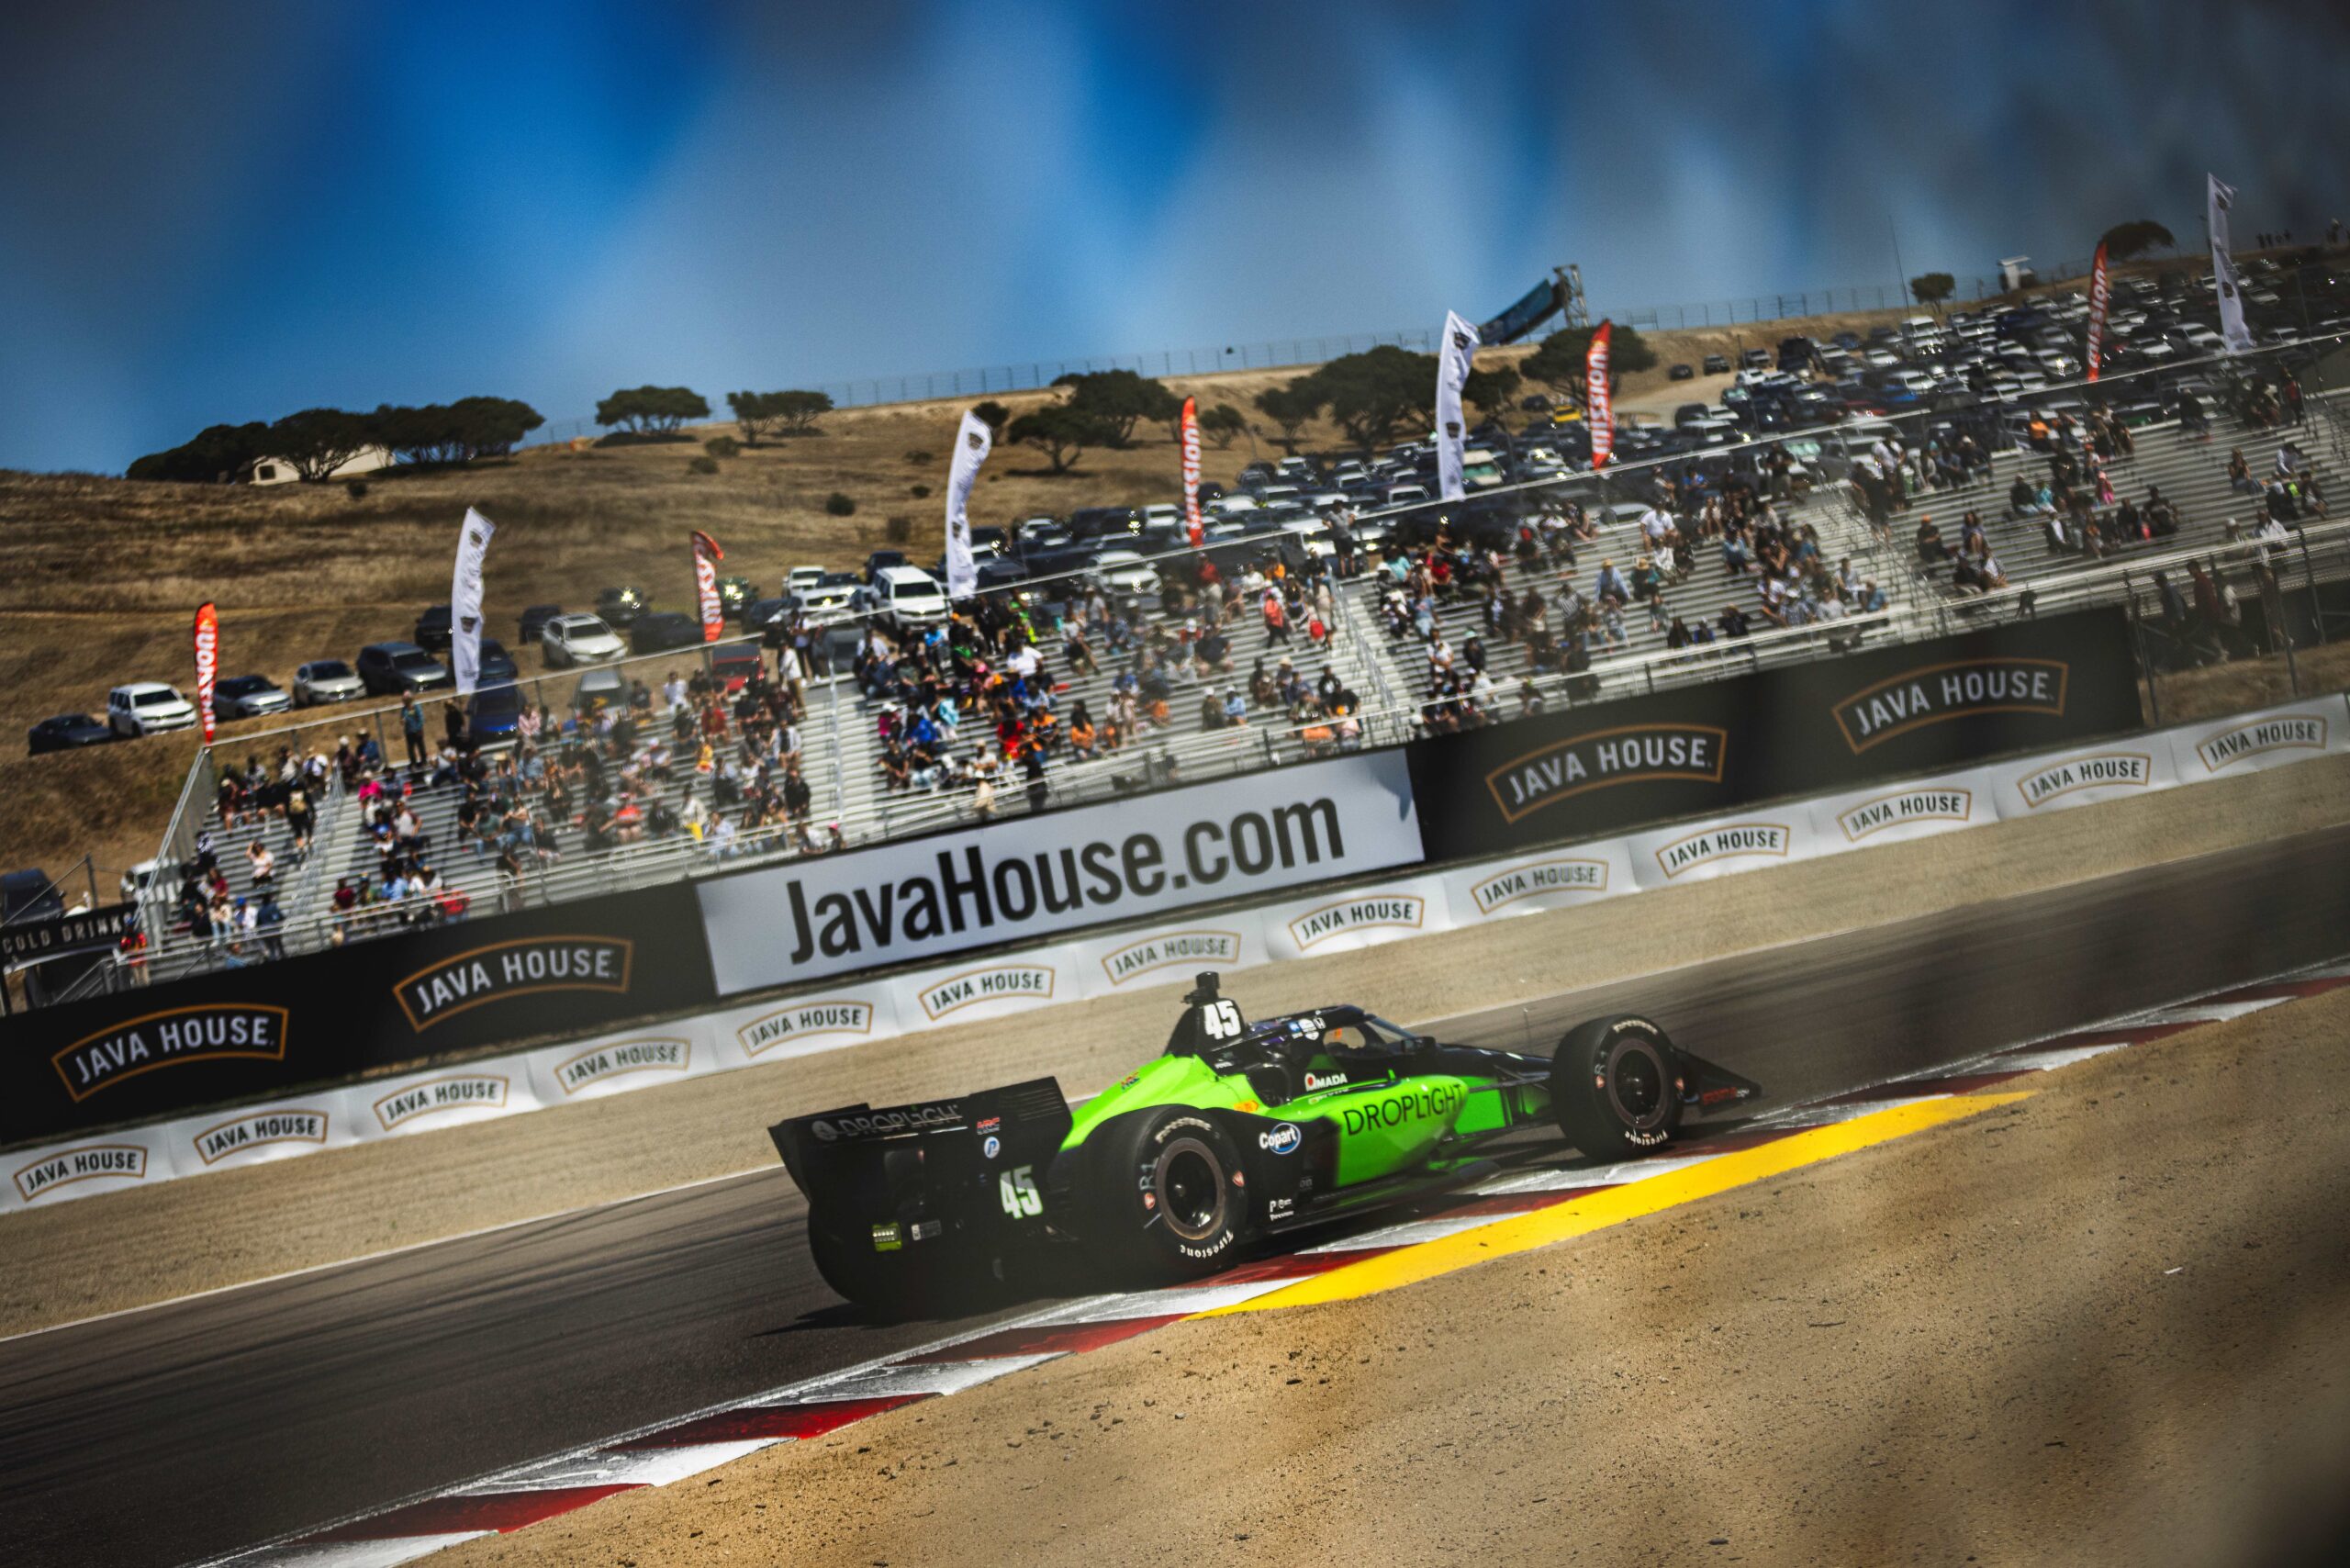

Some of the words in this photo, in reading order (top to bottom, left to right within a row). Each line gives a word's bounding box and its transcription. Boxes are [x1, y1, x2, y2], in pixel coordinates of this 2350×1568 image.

[1855, 685, 1931, 735] JAVA
[2210, 735, 2253, 764] JAVA
[2256, 722, 2317, 747] HOUSE
[1508, 752, 1588, 804] JAVA
[2029, 769, 2074, 799] JAVA
[2079, 760, 2142, 782] HOUSE
[1852, 803, 1895, 833] JAVA
[1899, 794, 1962, 816] HOUSE
[1667, 838, 1713, 868] JAVA
[1717, 829, 1780, 851] HOUSE
[787, 797, 1345, 966] JavaHouse.com
[1483, 875, 1528, 904] JAVA
[1532, 865, 1597, 889] HOUSE
[2, 928, 51, 954] COLD
[1301, 910, 1345, 940] JAVA
[1350, 902, 1413, 924] HOUSE
[1114, 947, 1158, 974] JAVA
[1164, 937, 1230, 963] HOUSE
[417, 962, 494, 1014] JAVA
[931, 981, 975, 1011] JAVA
[980, 972, 1043, 994] HOUSE
[750, 1021, 794, 1047] JAVA
[798, 1007, 863, 1029] HOUSE
[1203, 1000, 1242, 1040] 45
[76, 1033, 149, 1083] JAVA
[566, 1054, 611, 1083] JAVA
[614, 1043, 679, 1067] HOUSE
[385, 1090, 430, 1121] JAVA
[434, 1081, 497, 1104] HOUSE
[1342, 1083, 1462, 1137] DROPLIGHT
[206, 1126, 250, 1156] JAVA
[254, 1114, 316, 1139] HOUSE
[1259, 1126, 1297, 1150] Copart
[27, 1160, 70, 1193] JAVA
[74, 1152, 137, 1175] HOUSE
[1000, 1164, 1044, 1220] 45
[1181, 1229, 1235, 1259] Firestone
